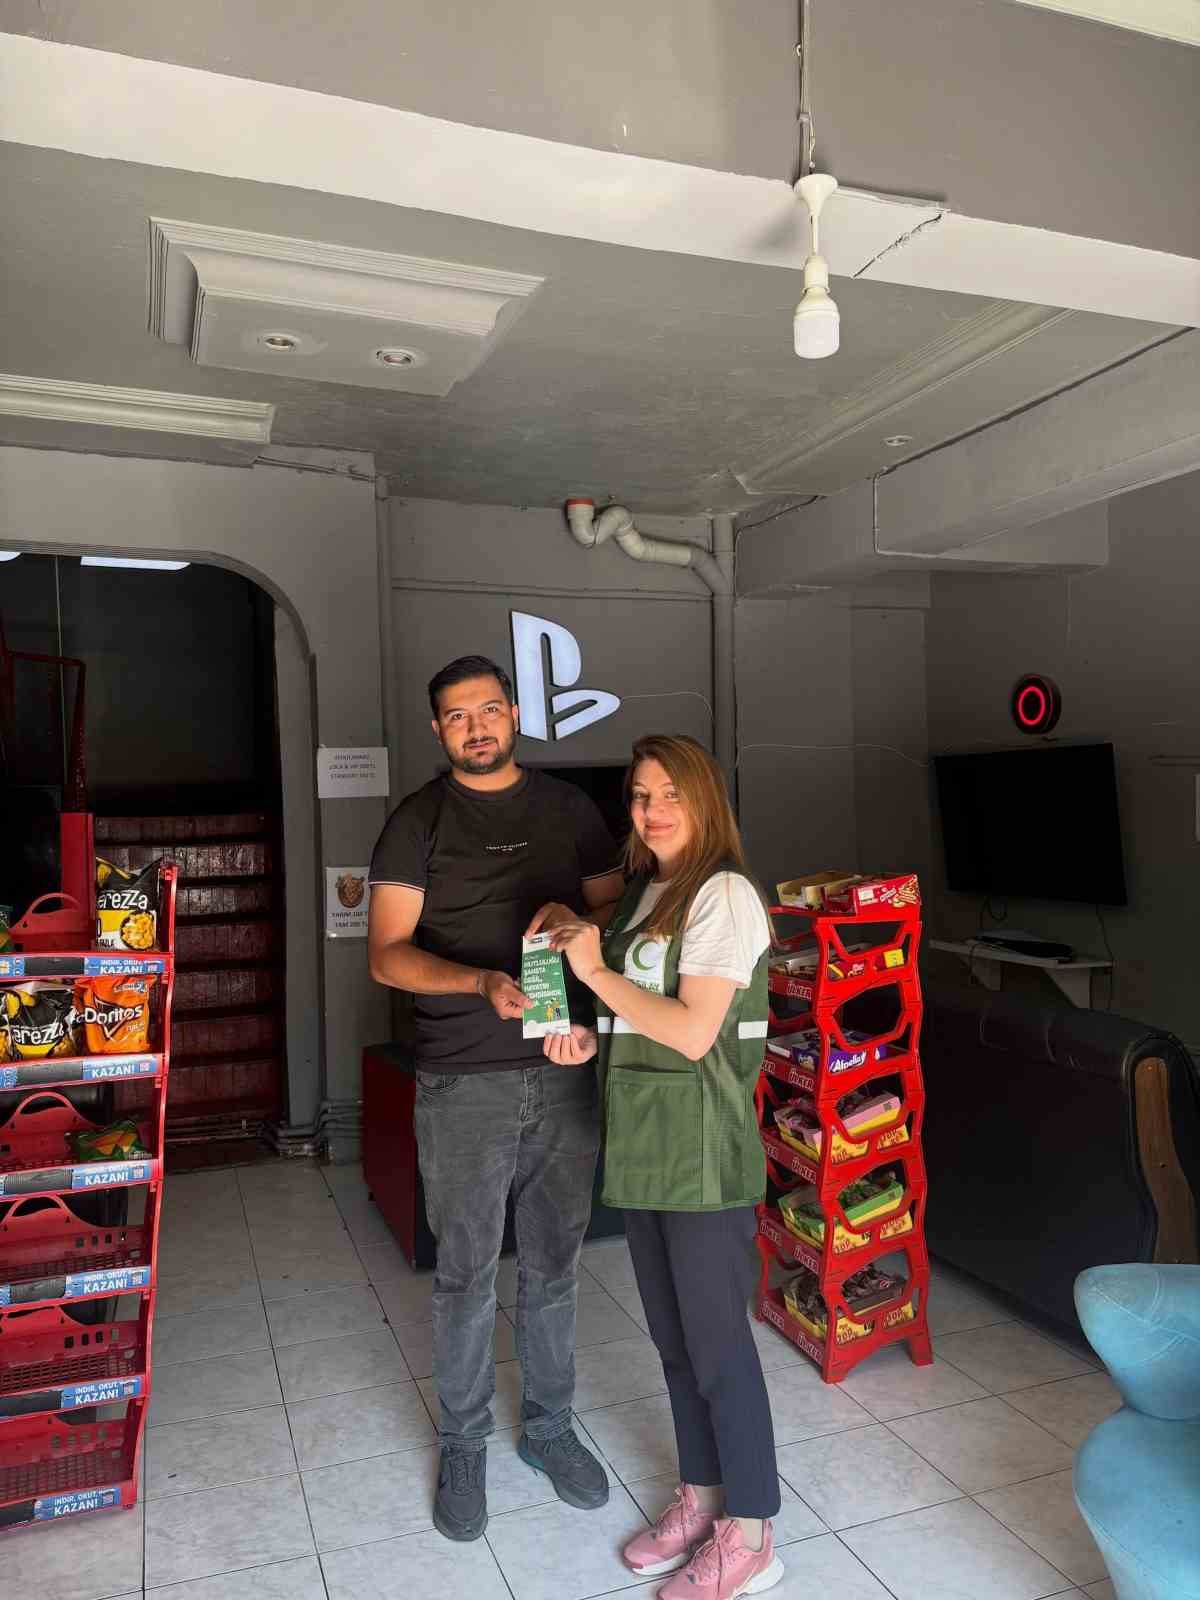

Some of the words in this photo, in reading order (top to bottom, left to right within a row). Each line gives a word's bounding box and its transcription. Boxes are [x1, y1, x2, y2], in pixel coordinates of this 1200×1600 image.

[100, 965, 144, 974] KAZAN!
[84, 1005, 144, 1025] Doritos
[92, 1064, 135, 1078] KAZAN!
[85, 1171, 129, 1186] KAZAN!
[83, 1278, 128, 1294] KAZAN!
[75, 1388, 119, 1405] KAZAN!
[54, 1499, 98, 1517] KAZAN!
